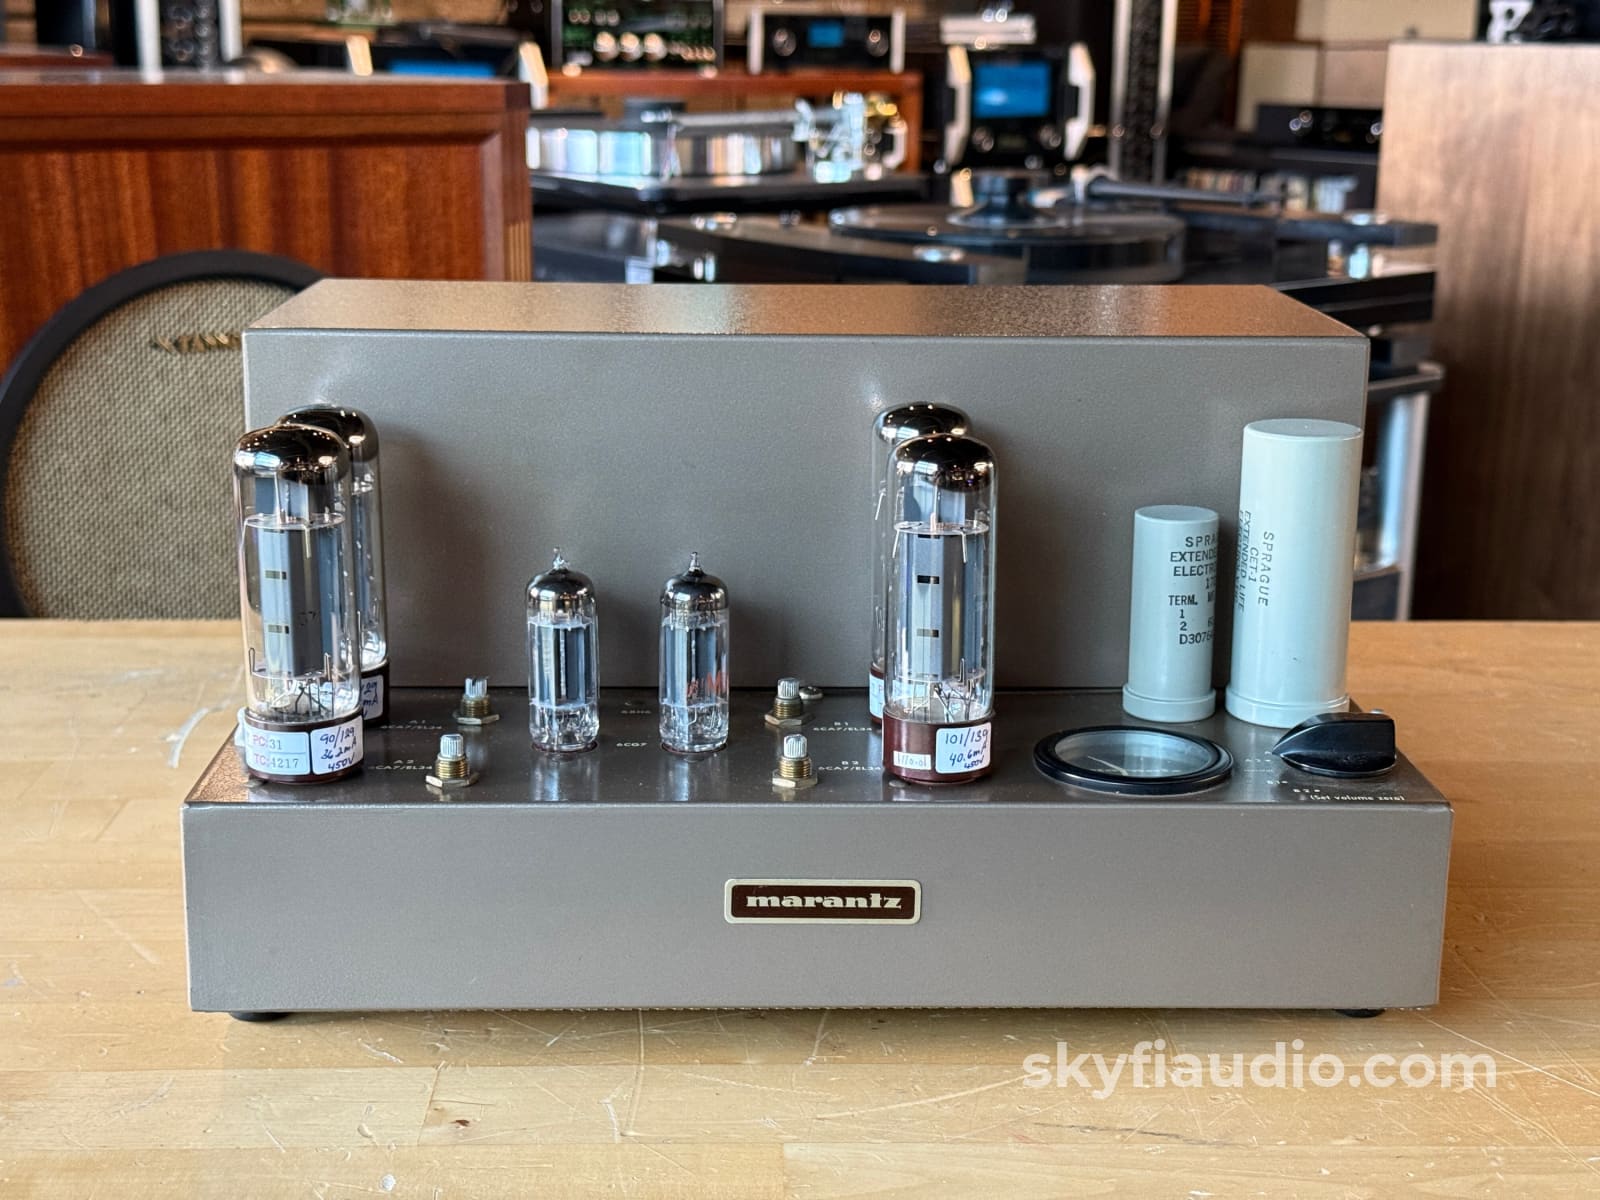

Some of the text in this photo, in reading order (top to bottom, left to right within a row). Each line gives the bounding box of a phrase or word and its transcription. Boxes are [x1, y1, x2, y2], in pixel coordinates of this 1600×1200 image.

[1248, 547, 1260, 582] CET-1
[1257, 531, 1275, 607] SPRAGUE
[1168, 594, 1198, 606] TERM.
[1179, 608, 1185, 619] 1
[1179, 621, 1187, 631] 2
[746, 892, 902, 909] marantz
